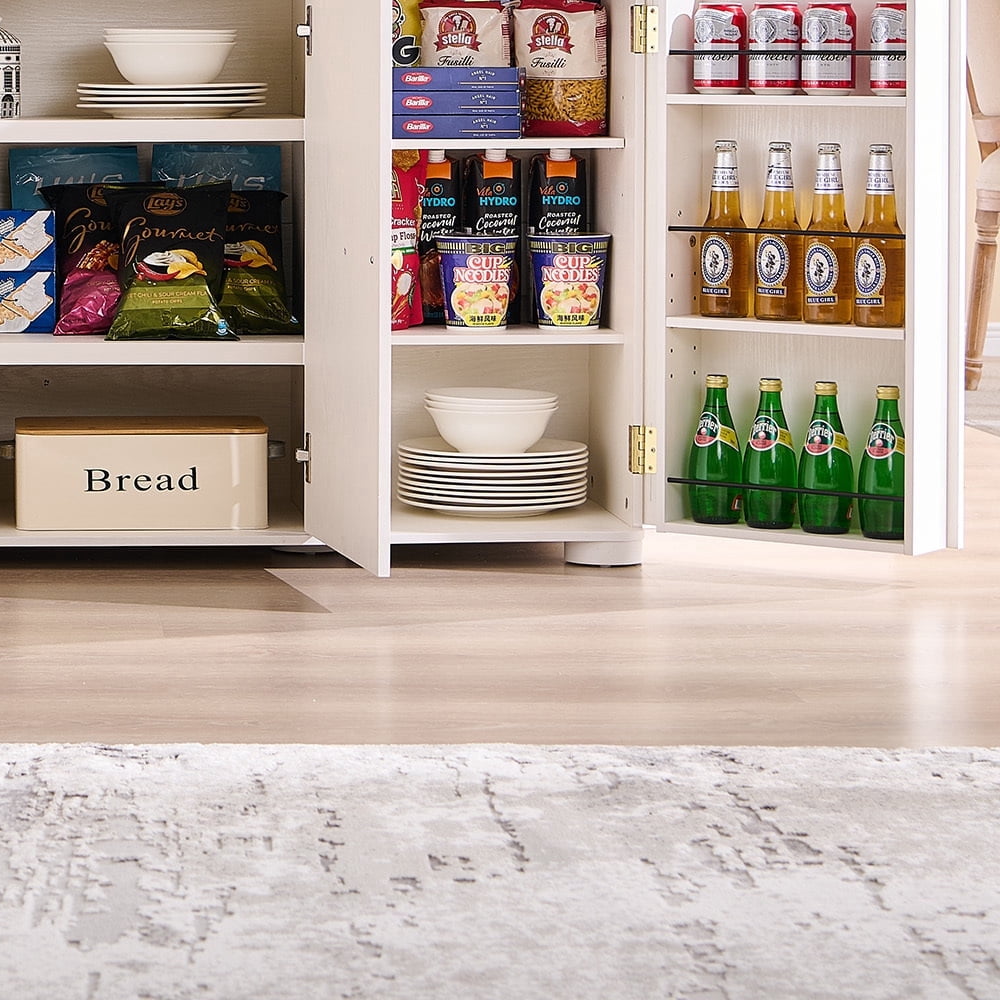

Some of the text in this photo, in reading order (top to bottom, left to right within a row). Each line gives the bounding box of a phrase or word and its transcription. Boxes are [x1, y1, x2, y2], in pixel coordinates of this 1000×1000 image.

[442, 33, 472, 45] stella
[535, 36, 565, 47] stella
[437, 55, 475, 66] Fusilli
[530, 57, 567, 68] Fusilli
[480, 196, 518, 206] HYDRO
[542, 196, 581, 206] HYDRO
[476, 214, 518, 231] Coconut
[538, 214, 582, 230] Coconut
[122, 216, 224, 267] Gourmet
[466, 242, 506, 254] BIG
[551, 242, 594, 254] BIG
[468, 256, 503, 268] CUP
[554, 255, 590, 268] CUP
[455, 268, 510, 282] NOODLES
[543, 268, 598, 282] NOODLES
[700, 418, 718, 432] errier
[83, 466, 200, 492] Bread
